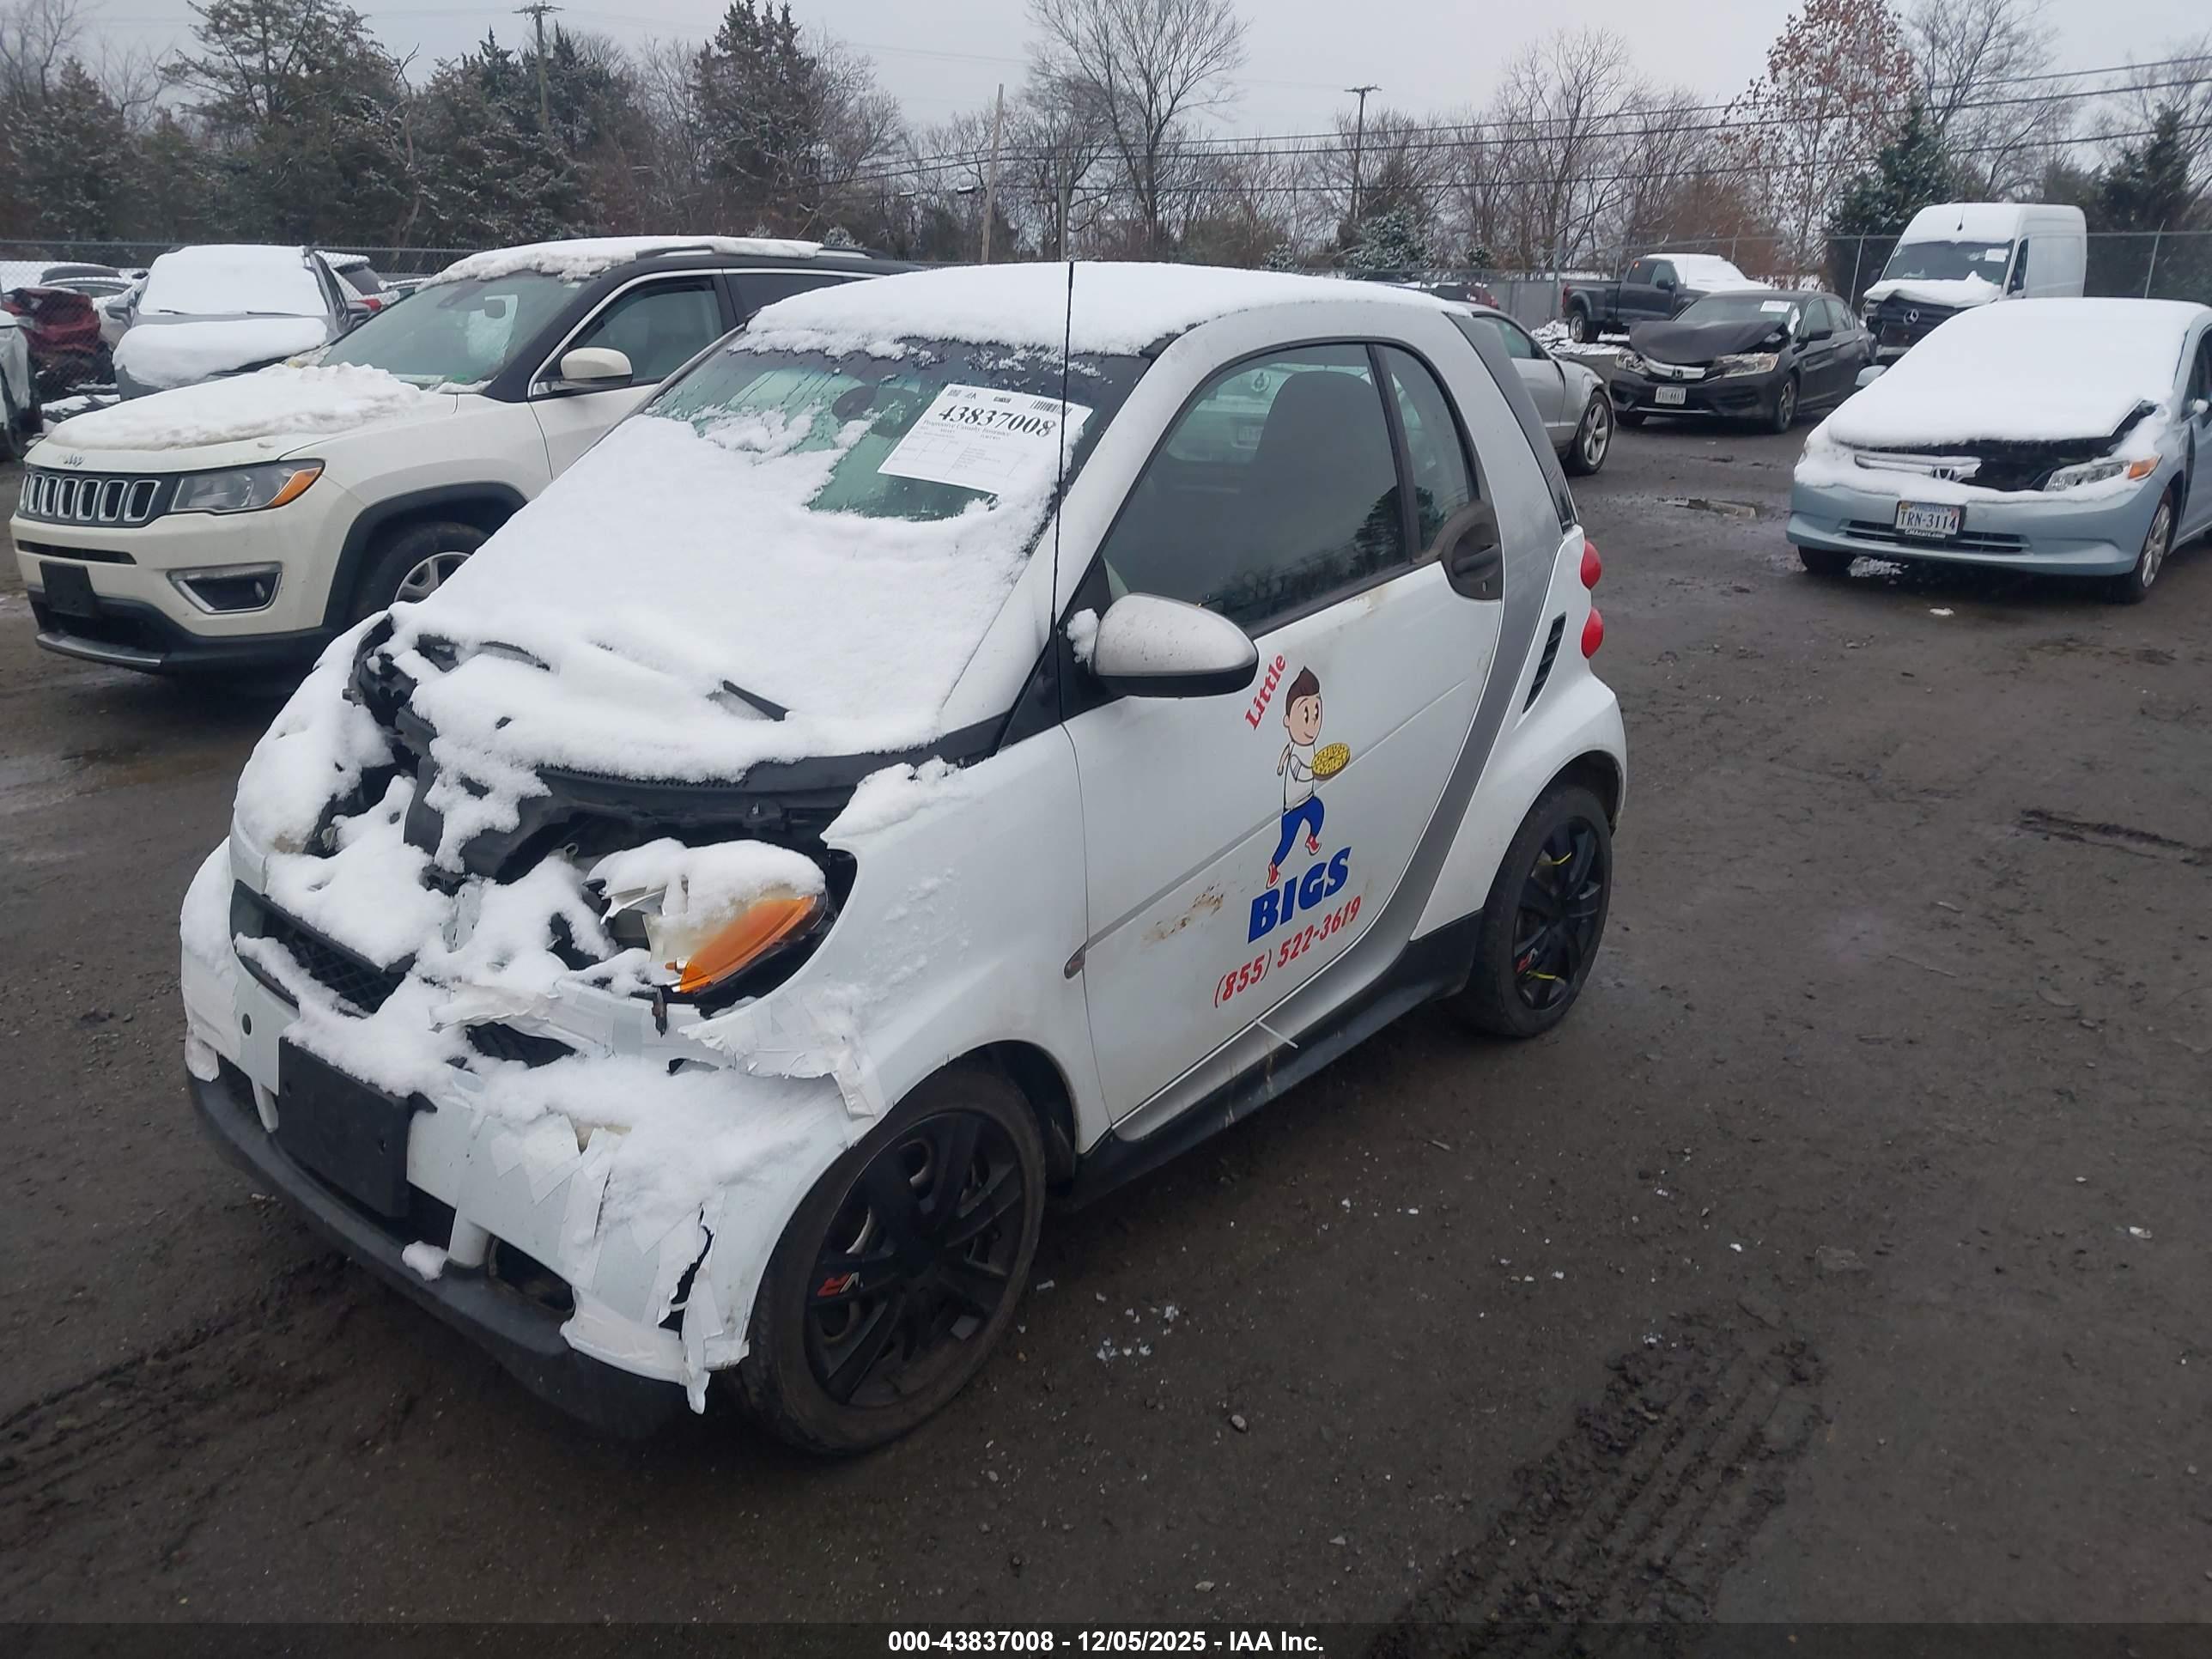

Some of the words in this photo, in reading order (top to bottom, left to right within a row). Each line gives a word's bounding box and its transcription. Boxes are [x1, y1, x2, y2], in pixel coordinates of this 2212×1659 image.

[939, 404, 1056, 438] 43837008
[1900, 510, 1957, 530] TRN-3114
[1244, 653, 1287, 731] Little
[1248, 847, 1352, 944] BIGS
[1214, 948, 1272, 1009] (855)
[1277, 895, 1362, 969] 522-3619
